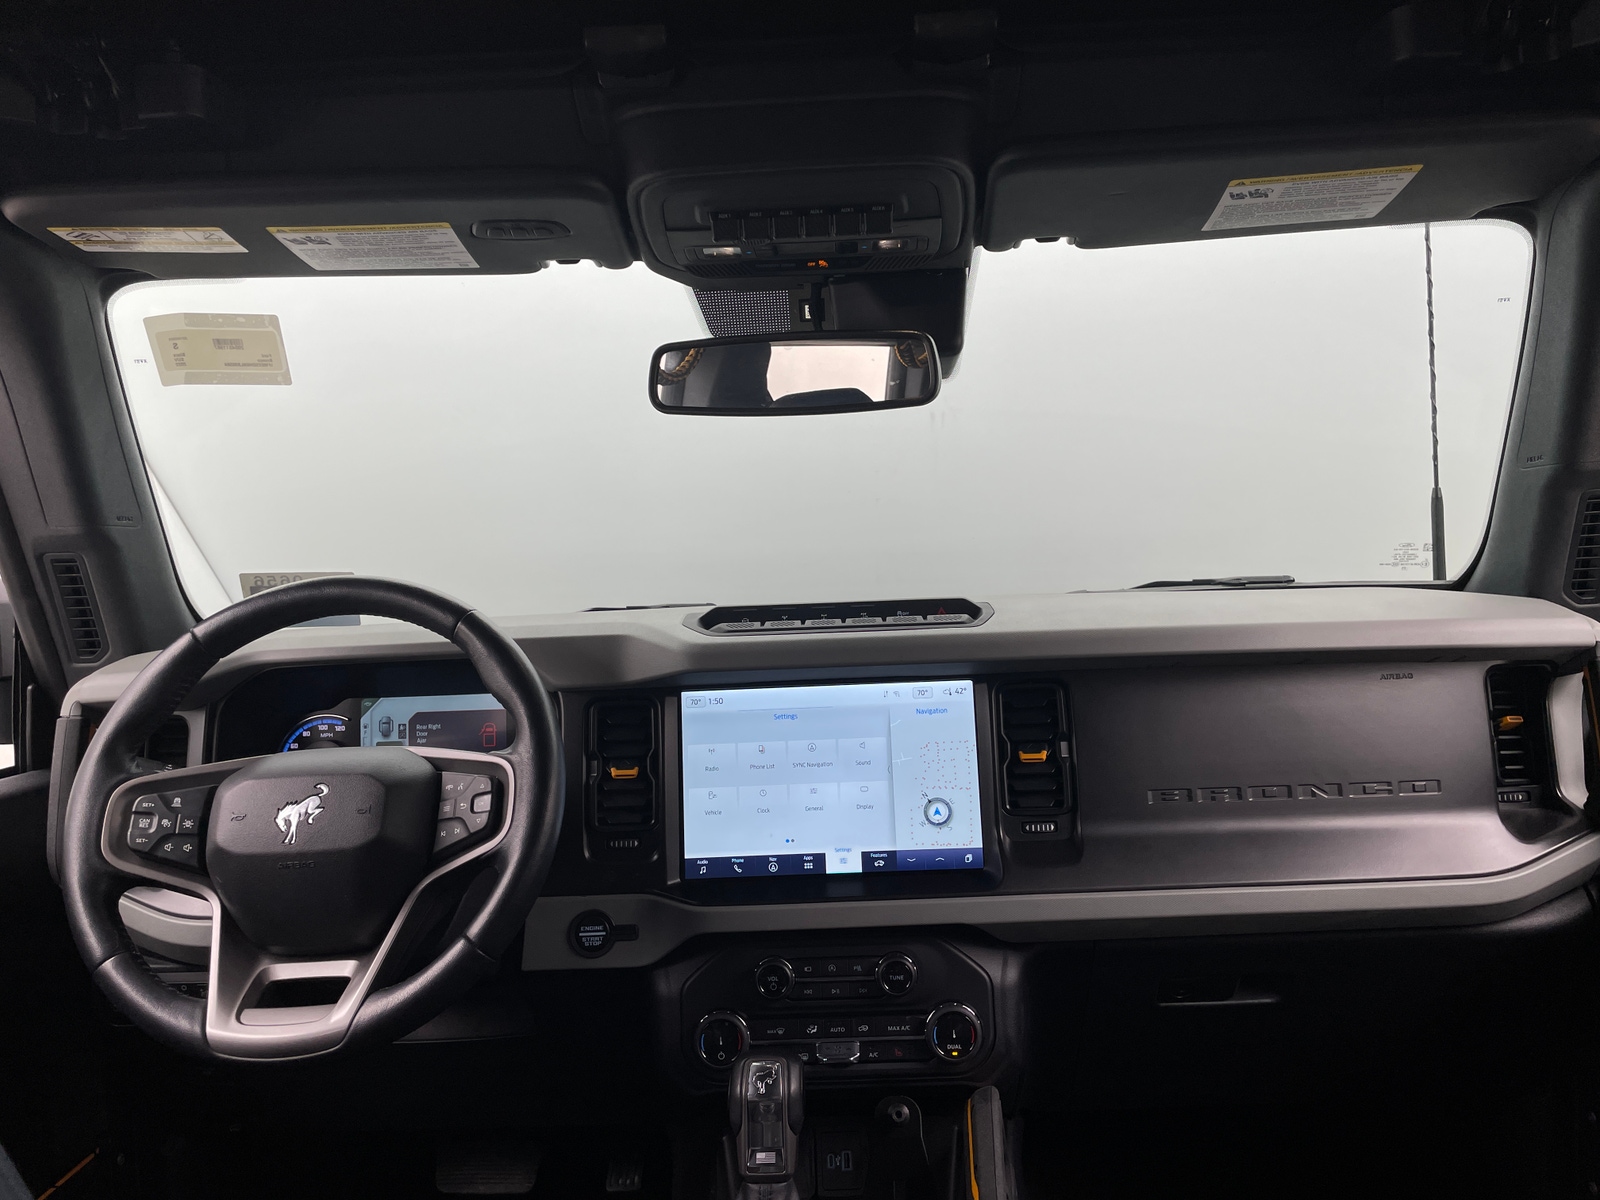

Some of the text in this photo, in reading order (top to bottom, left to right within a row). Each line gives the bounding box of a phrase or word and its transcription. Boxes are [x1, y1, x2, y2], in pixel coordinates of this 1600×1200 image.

[1380, 672, 1414, 681] AIRBAG
[954, 687, 967, 695] 42°
[708, 697, 724, 705] 1:50
[915, 707, 948, 716] Navigation
[773, 713, 799, 721] Settings
[1148, 778, 1442, 805] BRONCO
[868, 1051, 879, 1059] A/C
